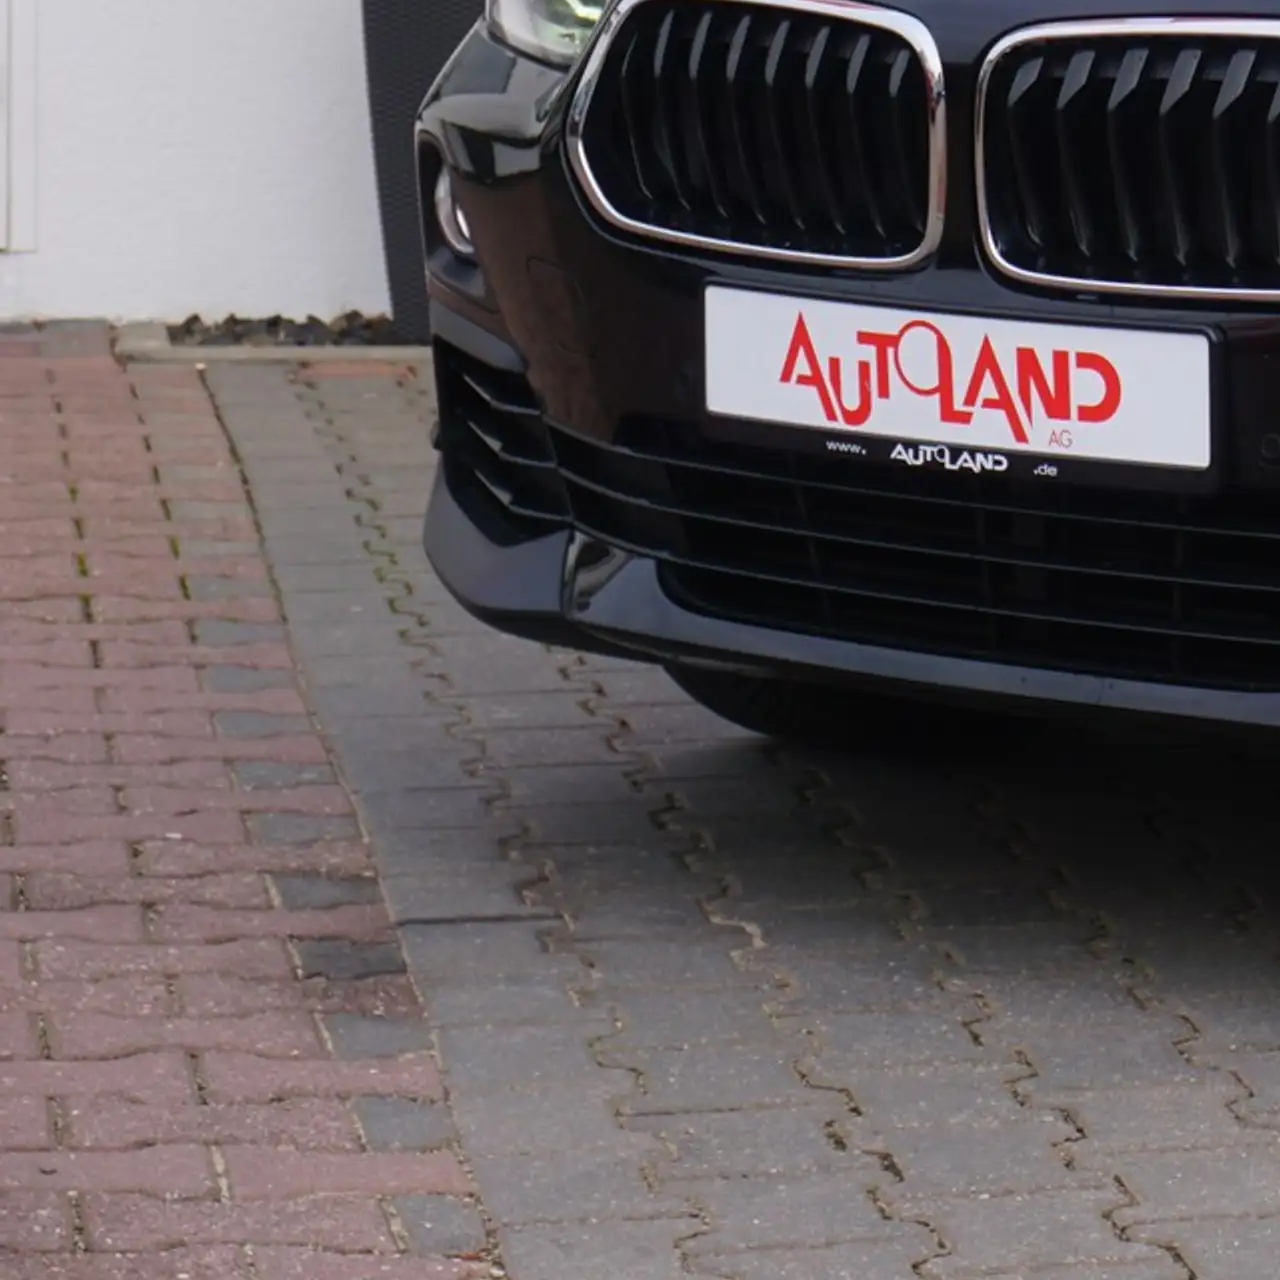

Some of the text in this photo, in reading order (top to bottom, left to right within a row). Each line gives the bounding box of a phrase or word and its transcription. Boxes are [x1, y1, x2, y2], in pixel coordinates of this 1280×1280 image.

[1048, 429, 1073, 449] AG
[826, 439, 867, 455] www.
[1033, 463, 1058, 477] .de
